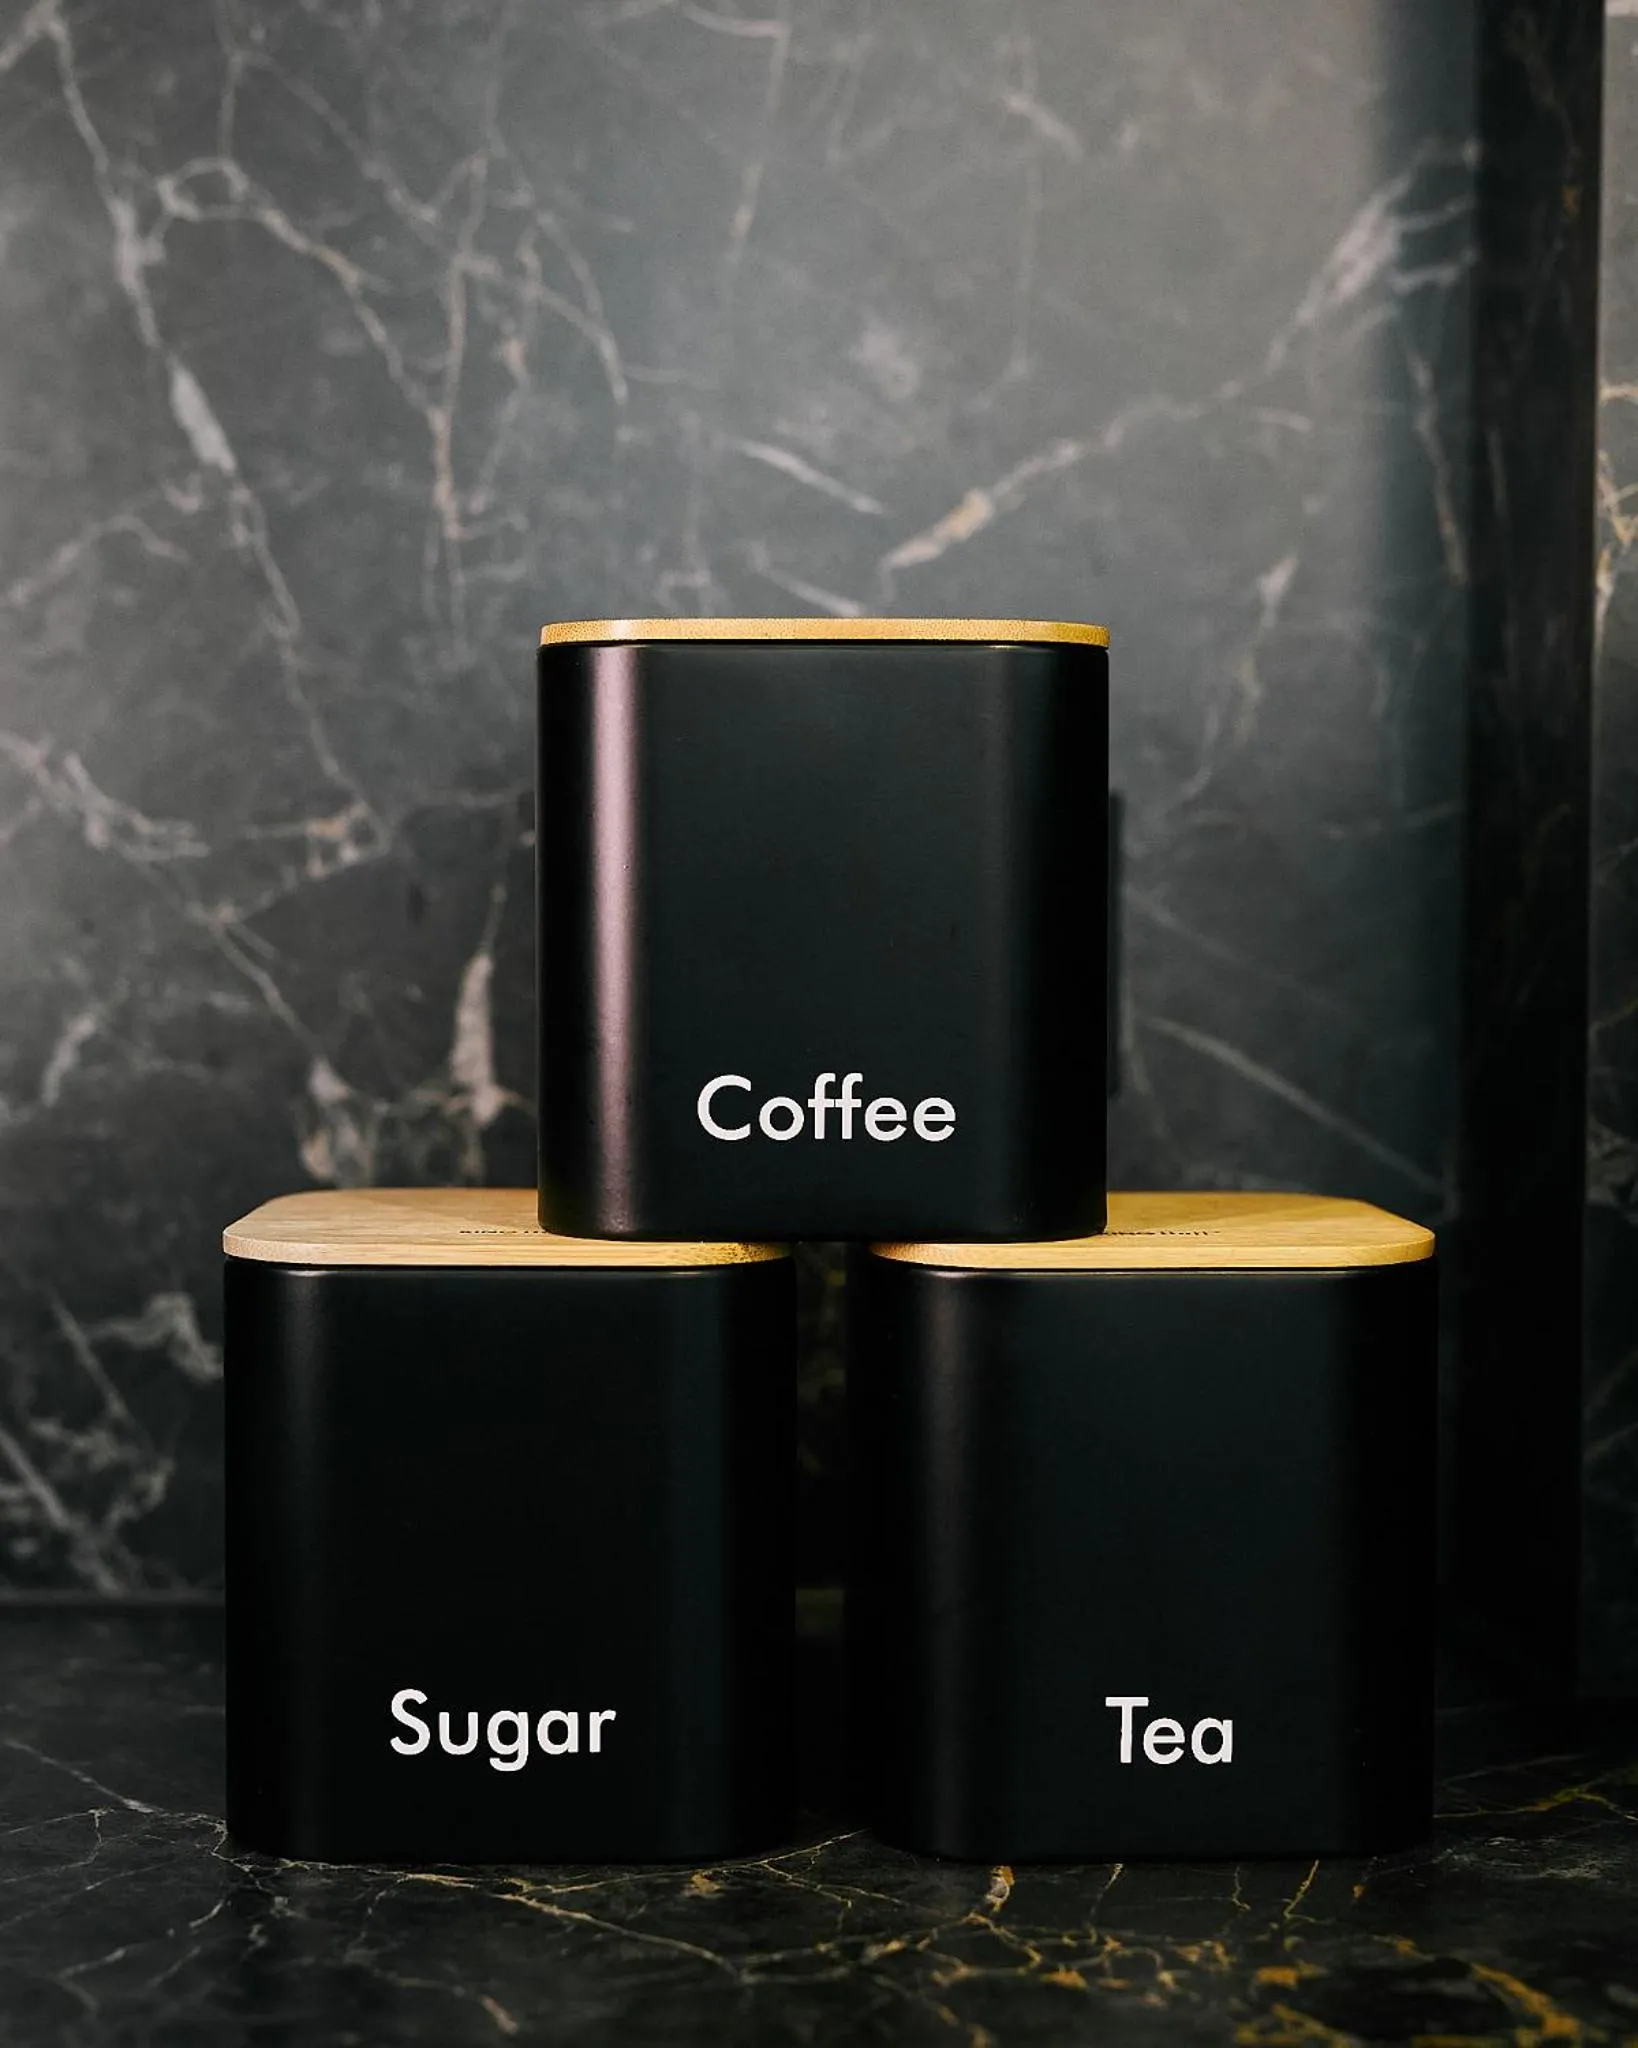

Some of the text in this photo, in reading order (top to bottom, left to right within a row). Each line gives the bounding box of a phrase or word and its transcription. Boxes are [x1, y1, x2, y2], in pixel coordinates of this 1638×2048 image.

[697, 1072, 956, 1142] Coffee
[390, 1688, 617, 1772] Sugar
[1105, 1696, 1233, 1765] Tea
